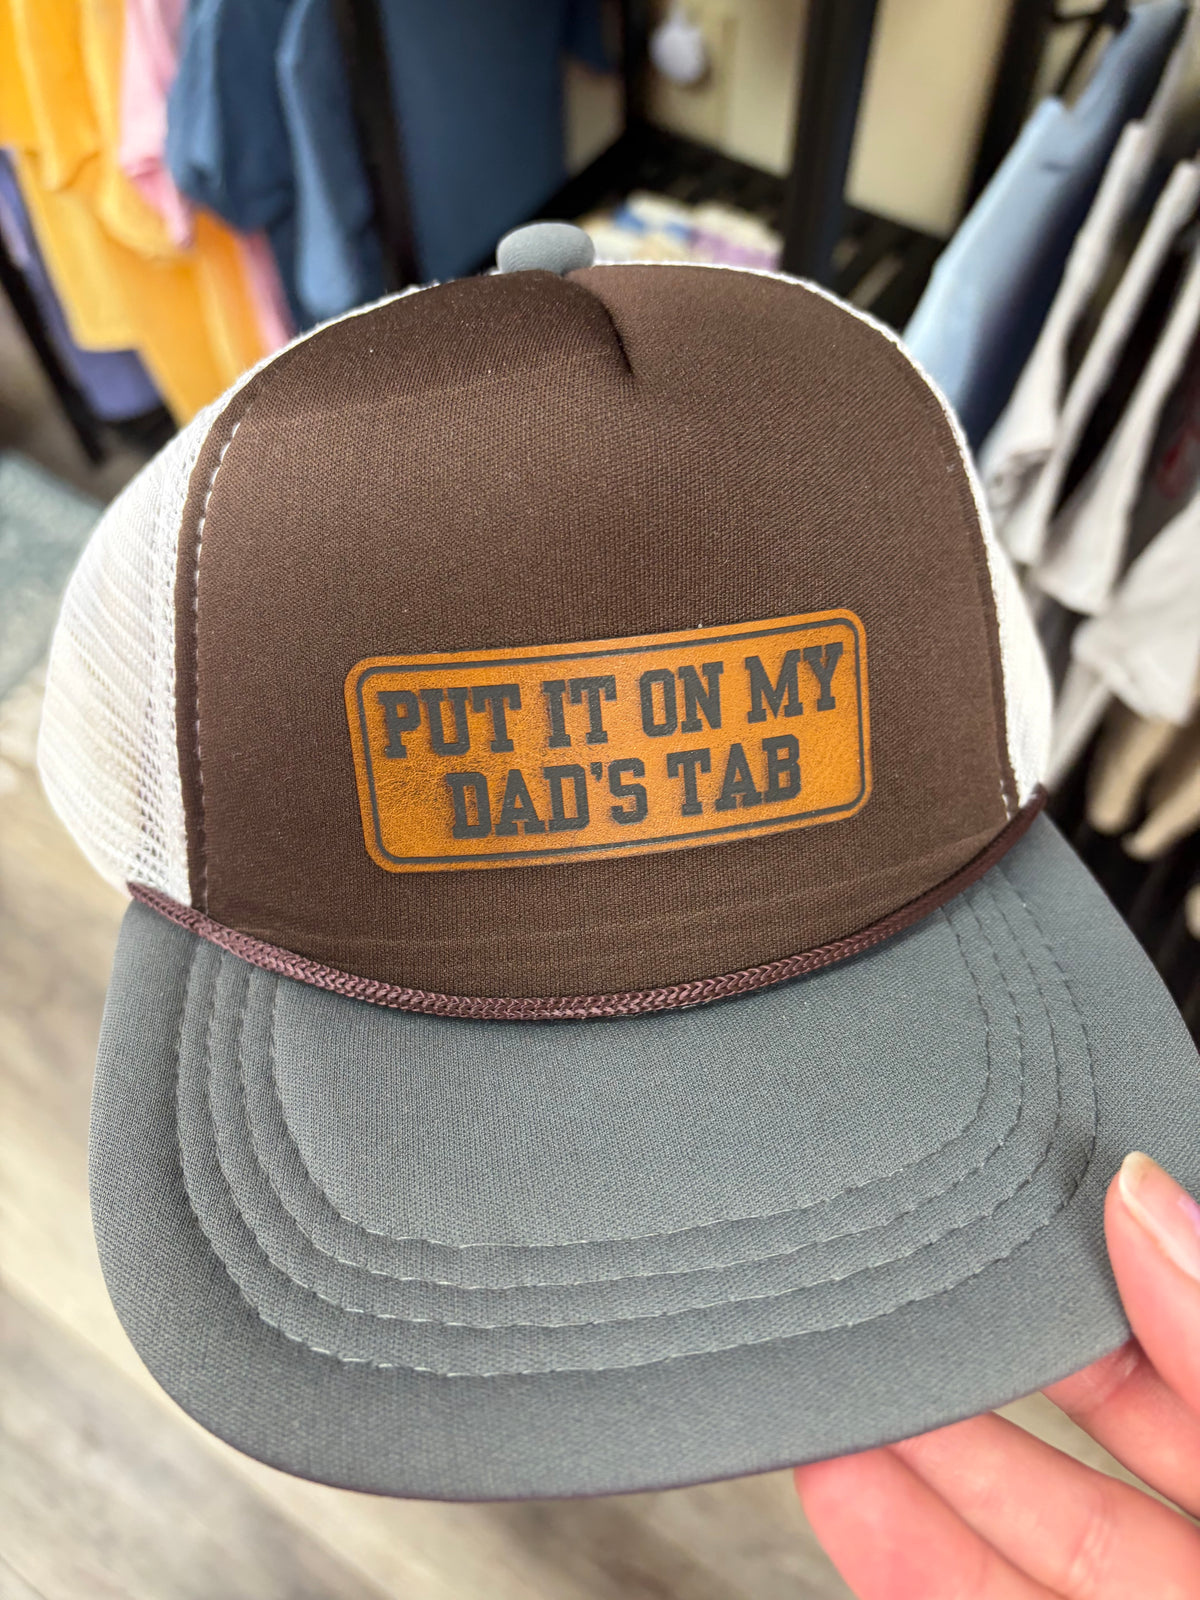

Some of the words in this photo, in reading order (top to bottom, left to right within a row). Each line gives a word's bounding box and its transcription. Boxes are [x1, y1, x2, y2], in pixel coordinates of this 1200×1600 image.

[377, 684, 521, 759] PUT
[542, 674, 617, 749] IT
[638, 661, 724, 738] ON
[744, 642, 844, 723] MY
[444, 757, 648, 839] DAD'S
[667, 733, 801, 817] TAB
